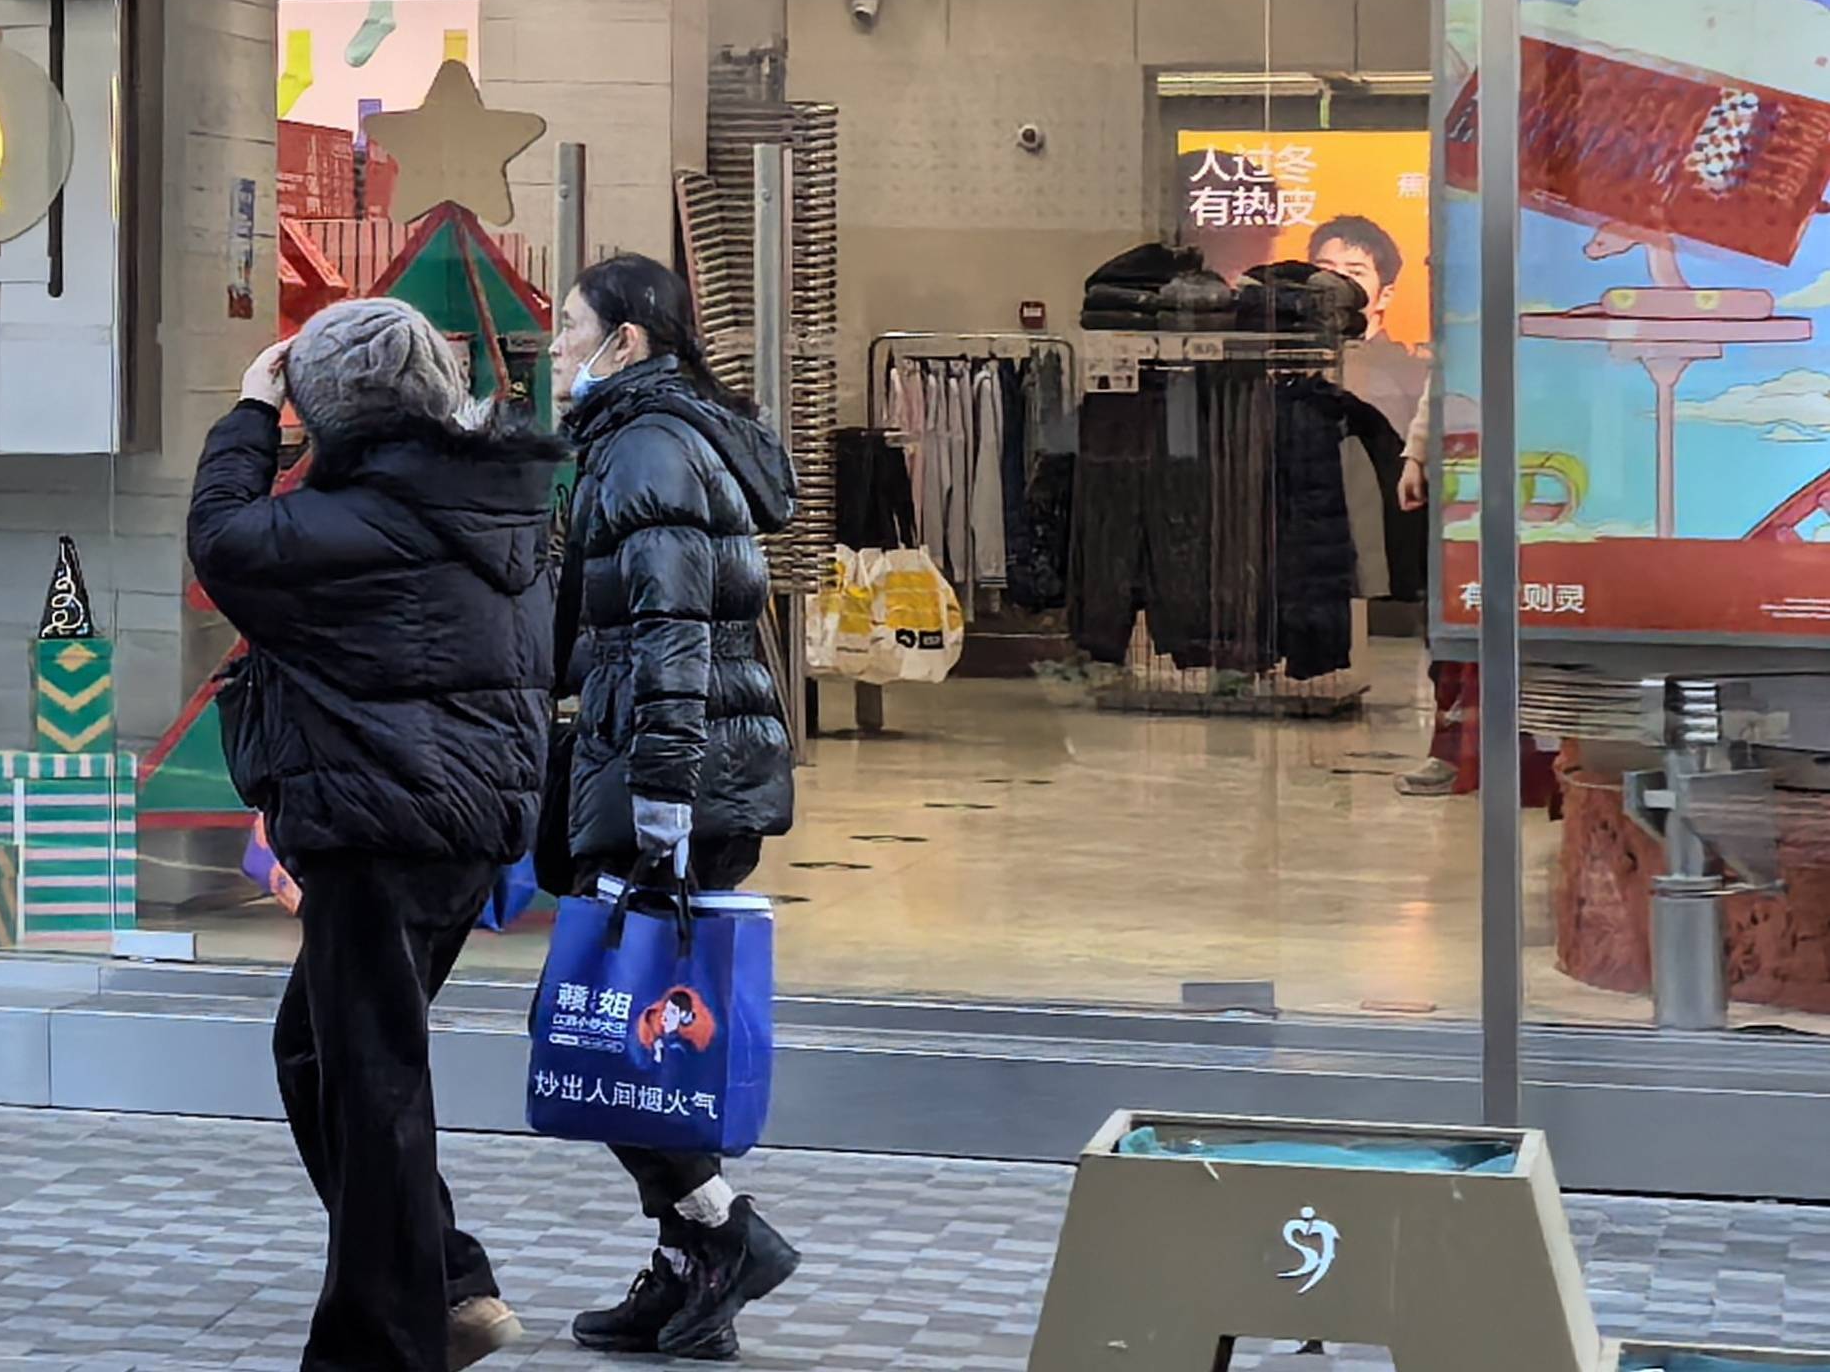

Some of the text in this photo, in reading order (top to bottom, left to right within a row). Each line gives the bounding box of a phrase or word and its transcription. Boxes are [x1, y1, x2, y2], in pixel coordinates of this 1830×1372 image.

[1189, 143, 1317, 184] 人过冬
[1189, 185, 1318, 228] 有热皮
[1459, 580, 1586, 614] 有则灵
[534, 1070, 719, 1119] 炒出人间烟火气
